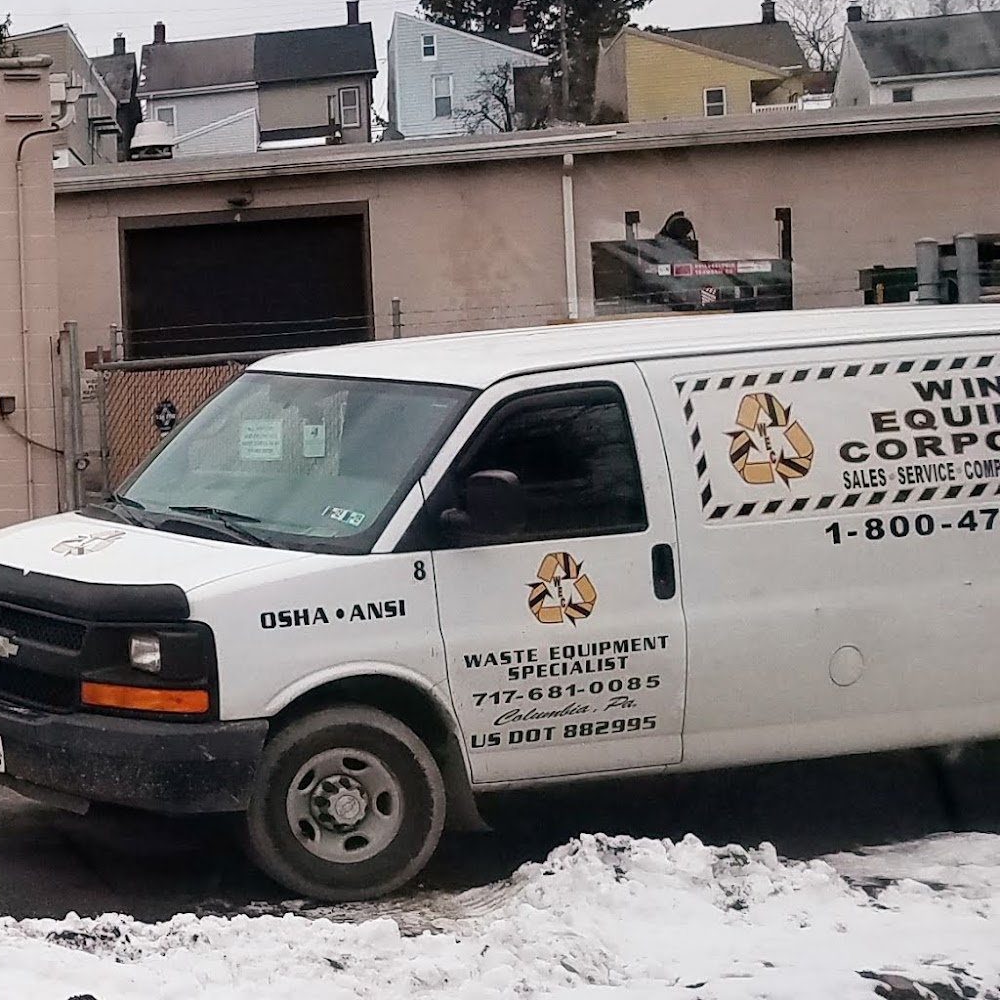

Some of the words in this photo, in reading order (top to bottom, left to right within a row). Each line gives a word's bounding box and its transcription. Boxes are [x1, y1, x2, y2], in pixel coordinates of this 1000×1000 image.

[843, 469, 887, 490] SALES
[897, 462, 956, 485] SERVICE
[825, 508, 1000, 545] 1-800-47
[413, 560, 426, 581] 8
[260, 607, 329, 629] OSHA
[350, 599, 406, 622] ANSI
[464, 648, 538, 668] WASTE
[549, 635, 669, 661] EQUIPMENT
[508, 655, 629, 681] SPECIALIST
[472, 675, 661, 707] 717-681-0085
[470, 732, 501, 749] US
[508, 726, 557, 745] DOT
[563, 715, 657, 739] 882995
